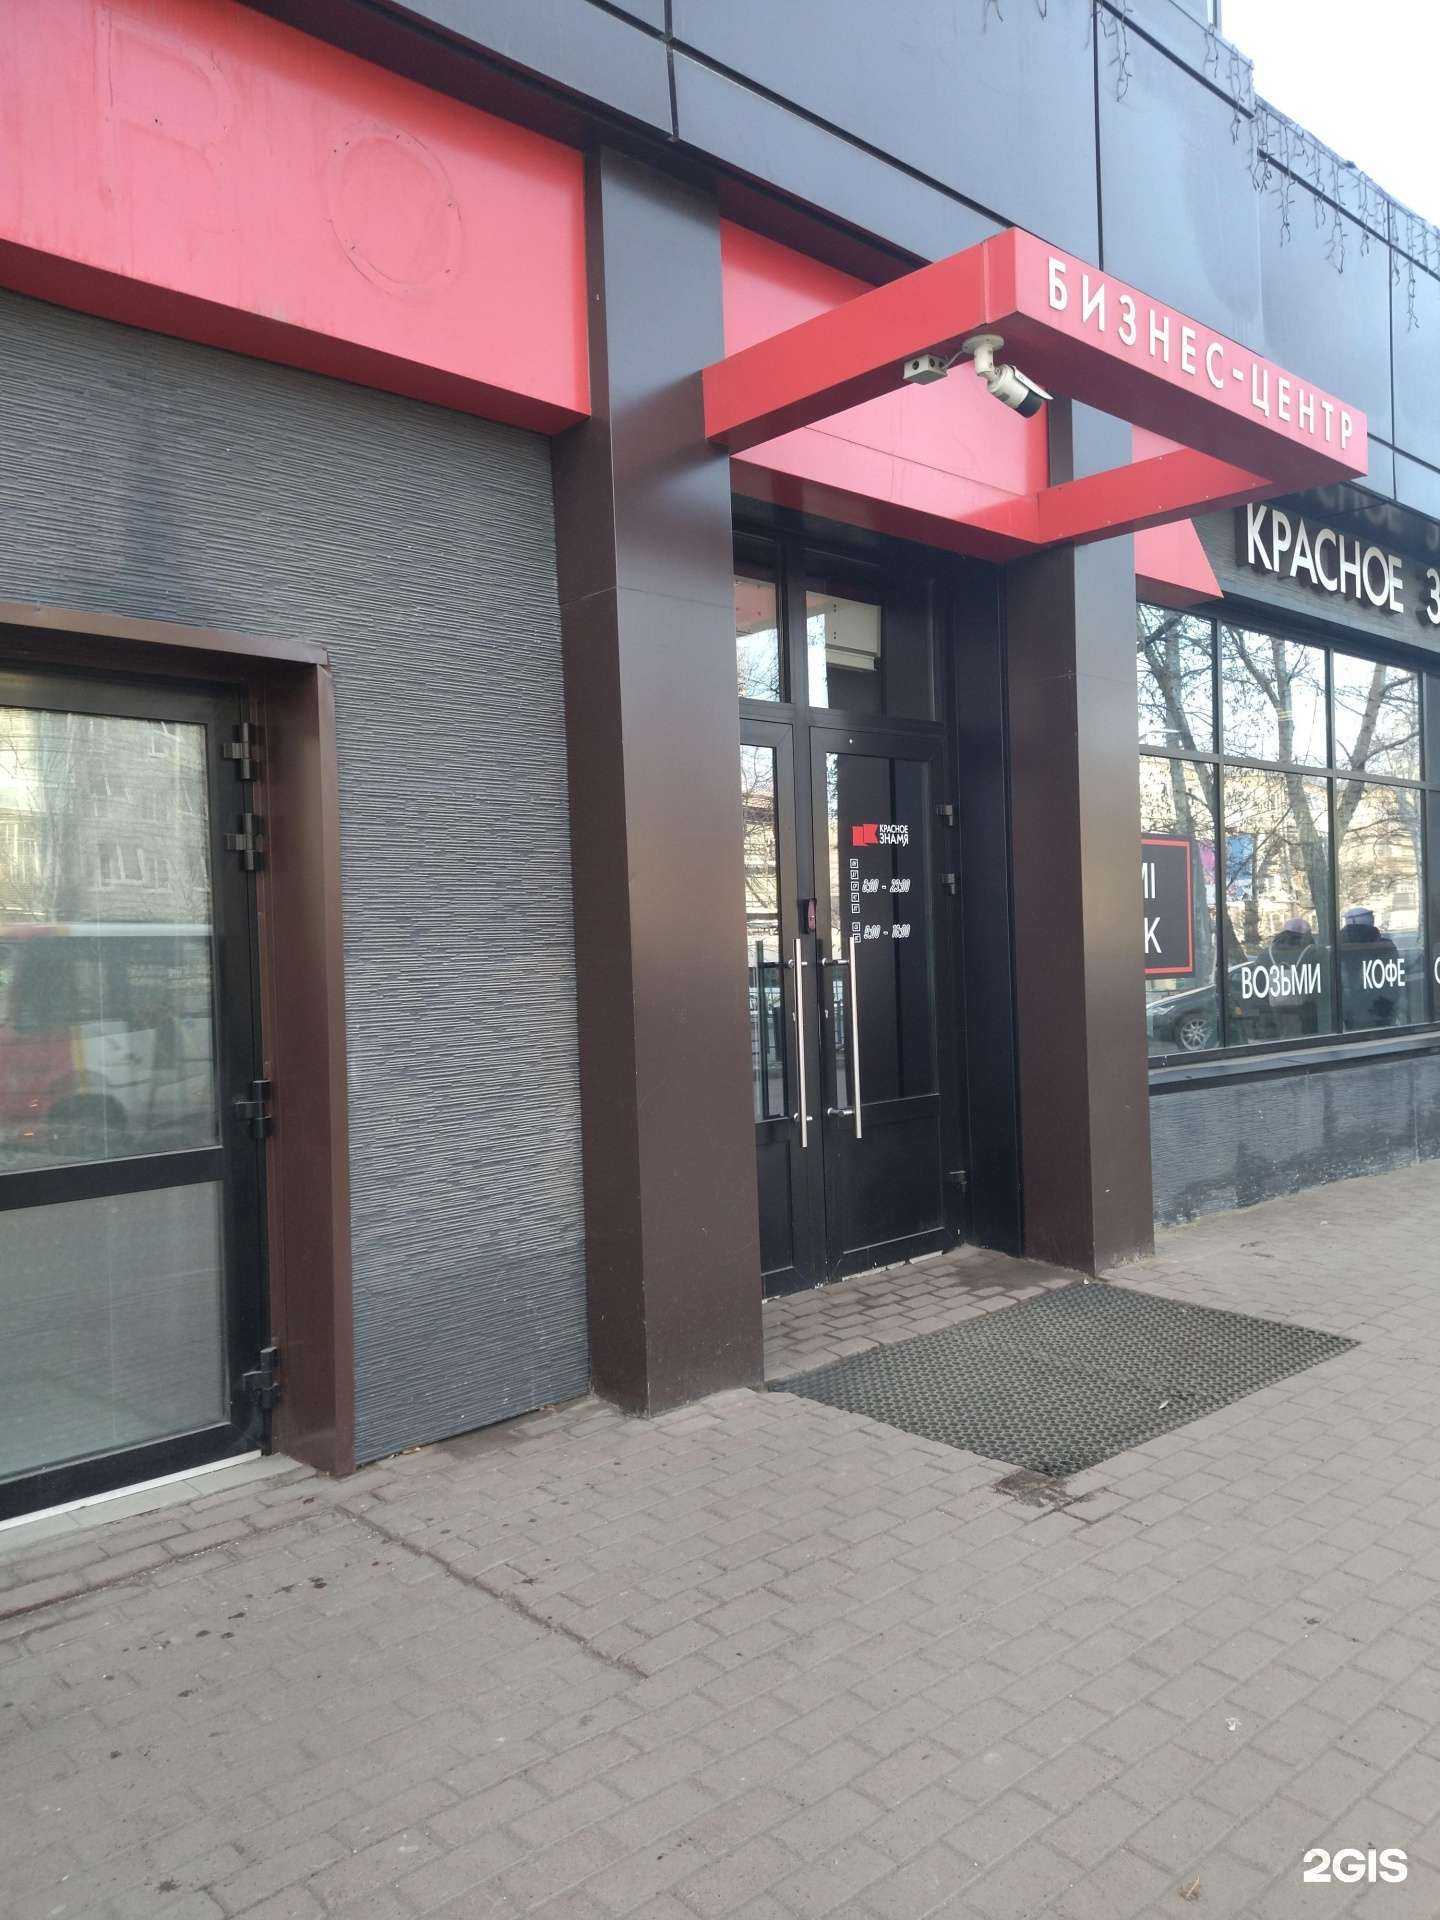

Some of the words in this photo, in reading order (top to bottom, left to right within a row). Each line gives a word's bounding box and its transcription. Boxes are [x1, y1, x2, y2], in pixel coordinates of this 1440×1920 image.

[1047, 256, 1353, 449] БИЗНЕС-ЦЕНТР
[1247, 502, 1404, 613] КРАСНОЕ
[879, 824, 909, 834] КРАСНОЕ
[879, 833, 909, 847] ЗНАМЯ
[1241, 963, 1322, 999] ВОЗЬМИ
[1363, 958, 1405, 989] КОФЕ
